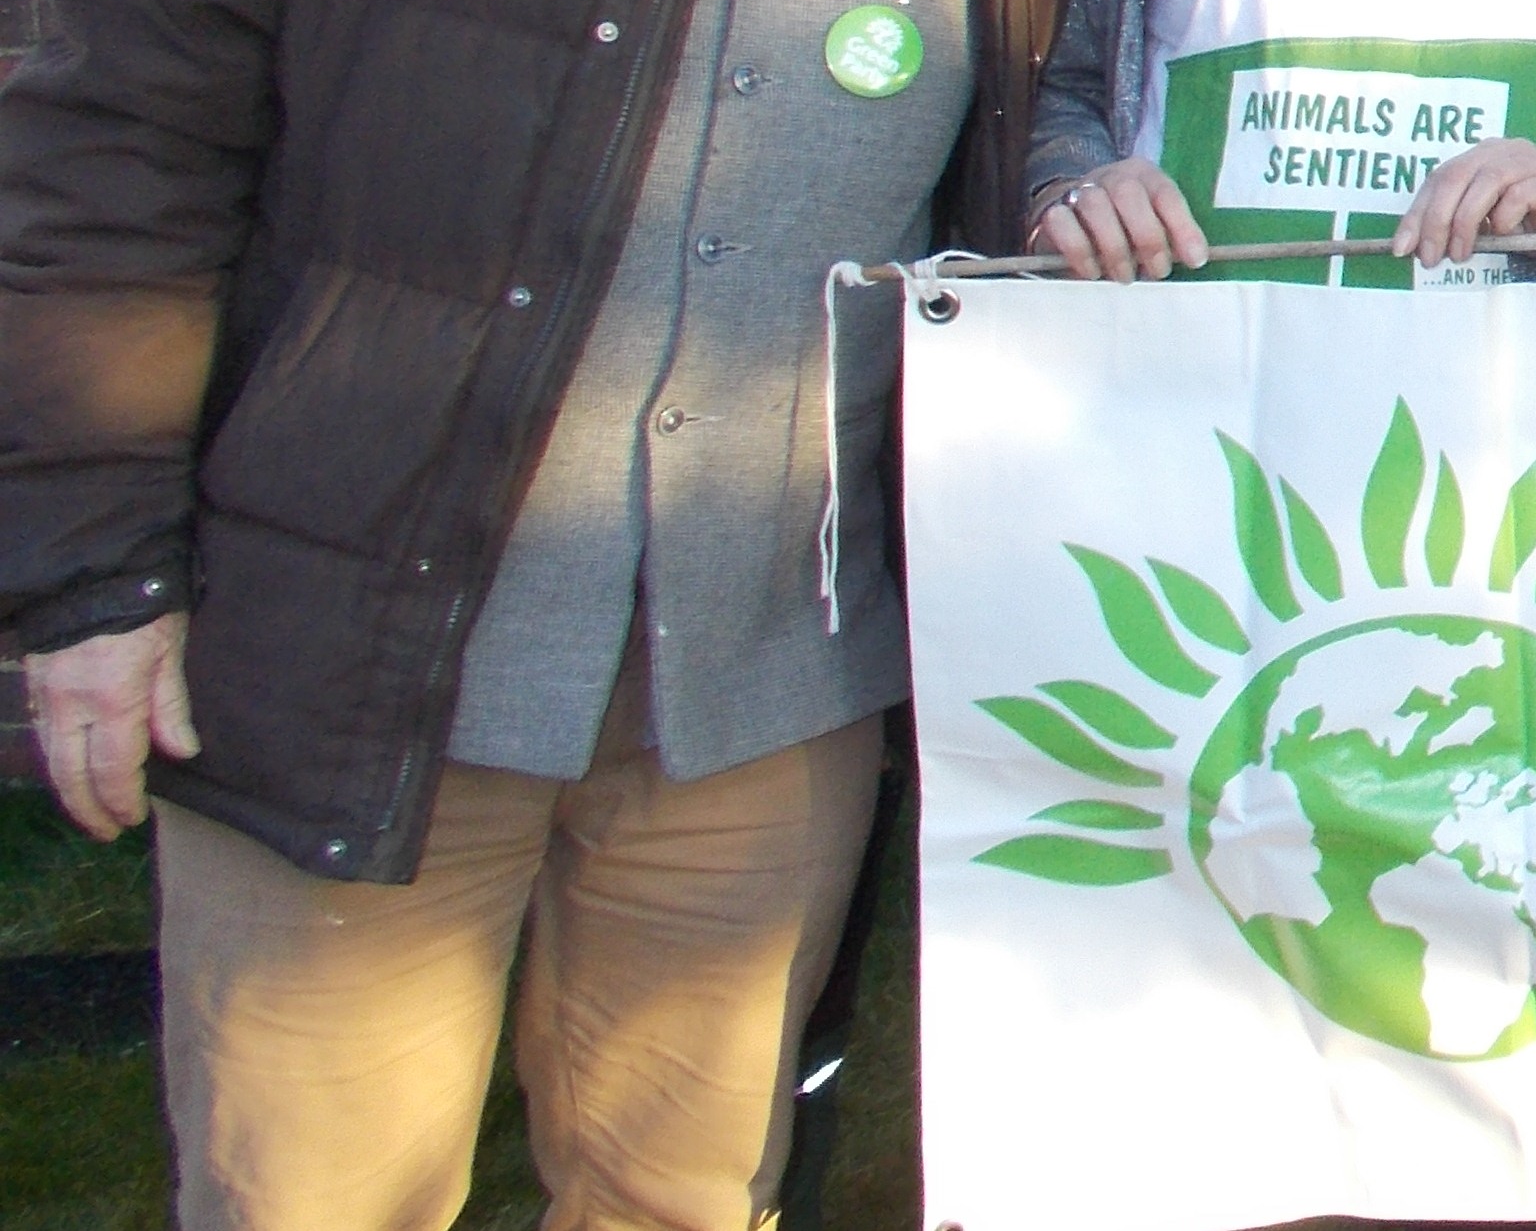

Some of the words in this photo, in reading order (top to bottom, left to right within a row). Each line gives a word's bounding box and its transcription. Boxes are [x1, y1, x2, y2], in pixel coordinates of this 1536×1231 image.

[847, 36, 900, 74] Green
[1241, 90, 1395, 136] ANIMALS
[1411, 103, 1485, 144] ARE
[1263, 144, 1441, 194] SENTIENT
